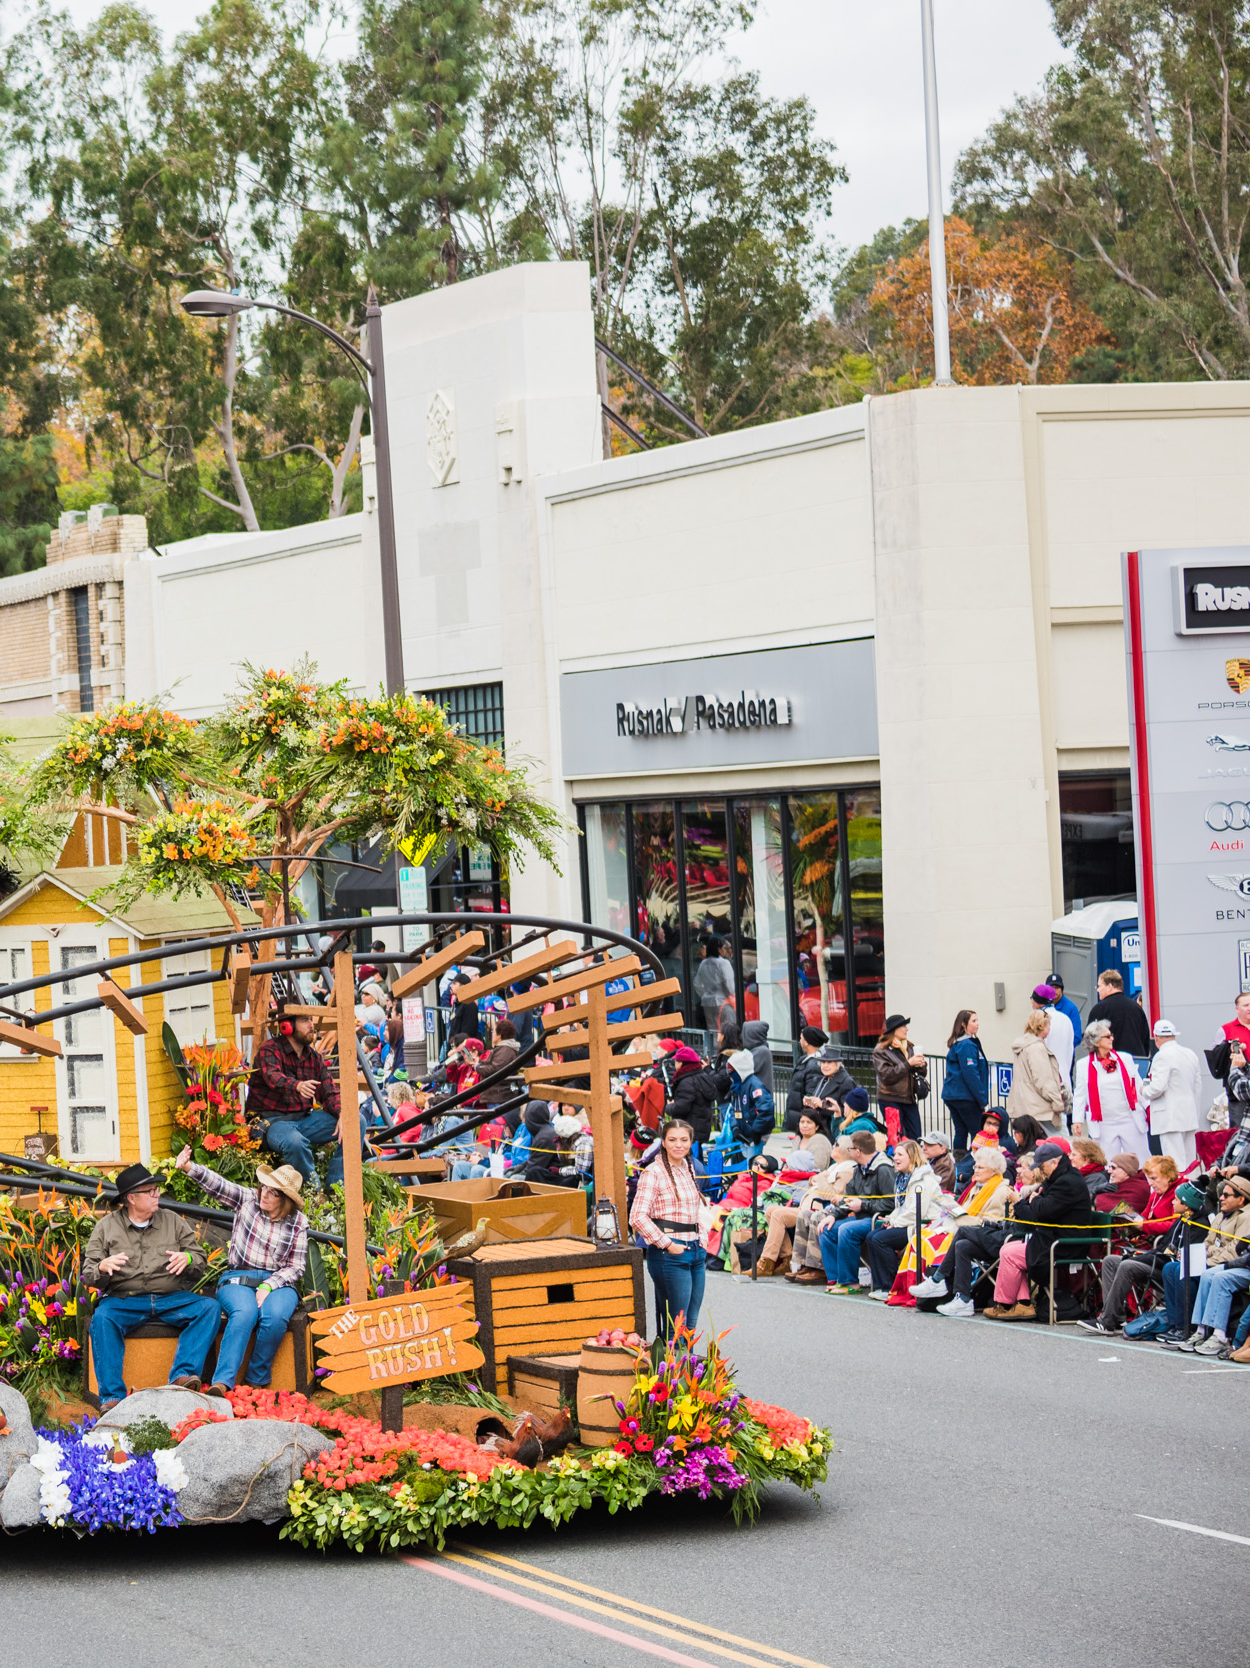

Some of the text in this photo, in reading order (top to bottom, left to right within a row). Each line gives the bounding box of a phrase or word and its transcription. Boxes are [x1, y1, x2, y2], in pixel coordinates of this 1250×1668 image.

[616, 697, 682, 737] Rusnak
[695, 690, 787, 730] Pasadena
[1198, 701, 1250, 709] PORS
[1210, 840, 1244, 851] Audi
[328, 1309, 360, 1339] THE
[358, 1303, 429, 1345] GOLD
[366, 1327, 457, 1380] RUSH!
